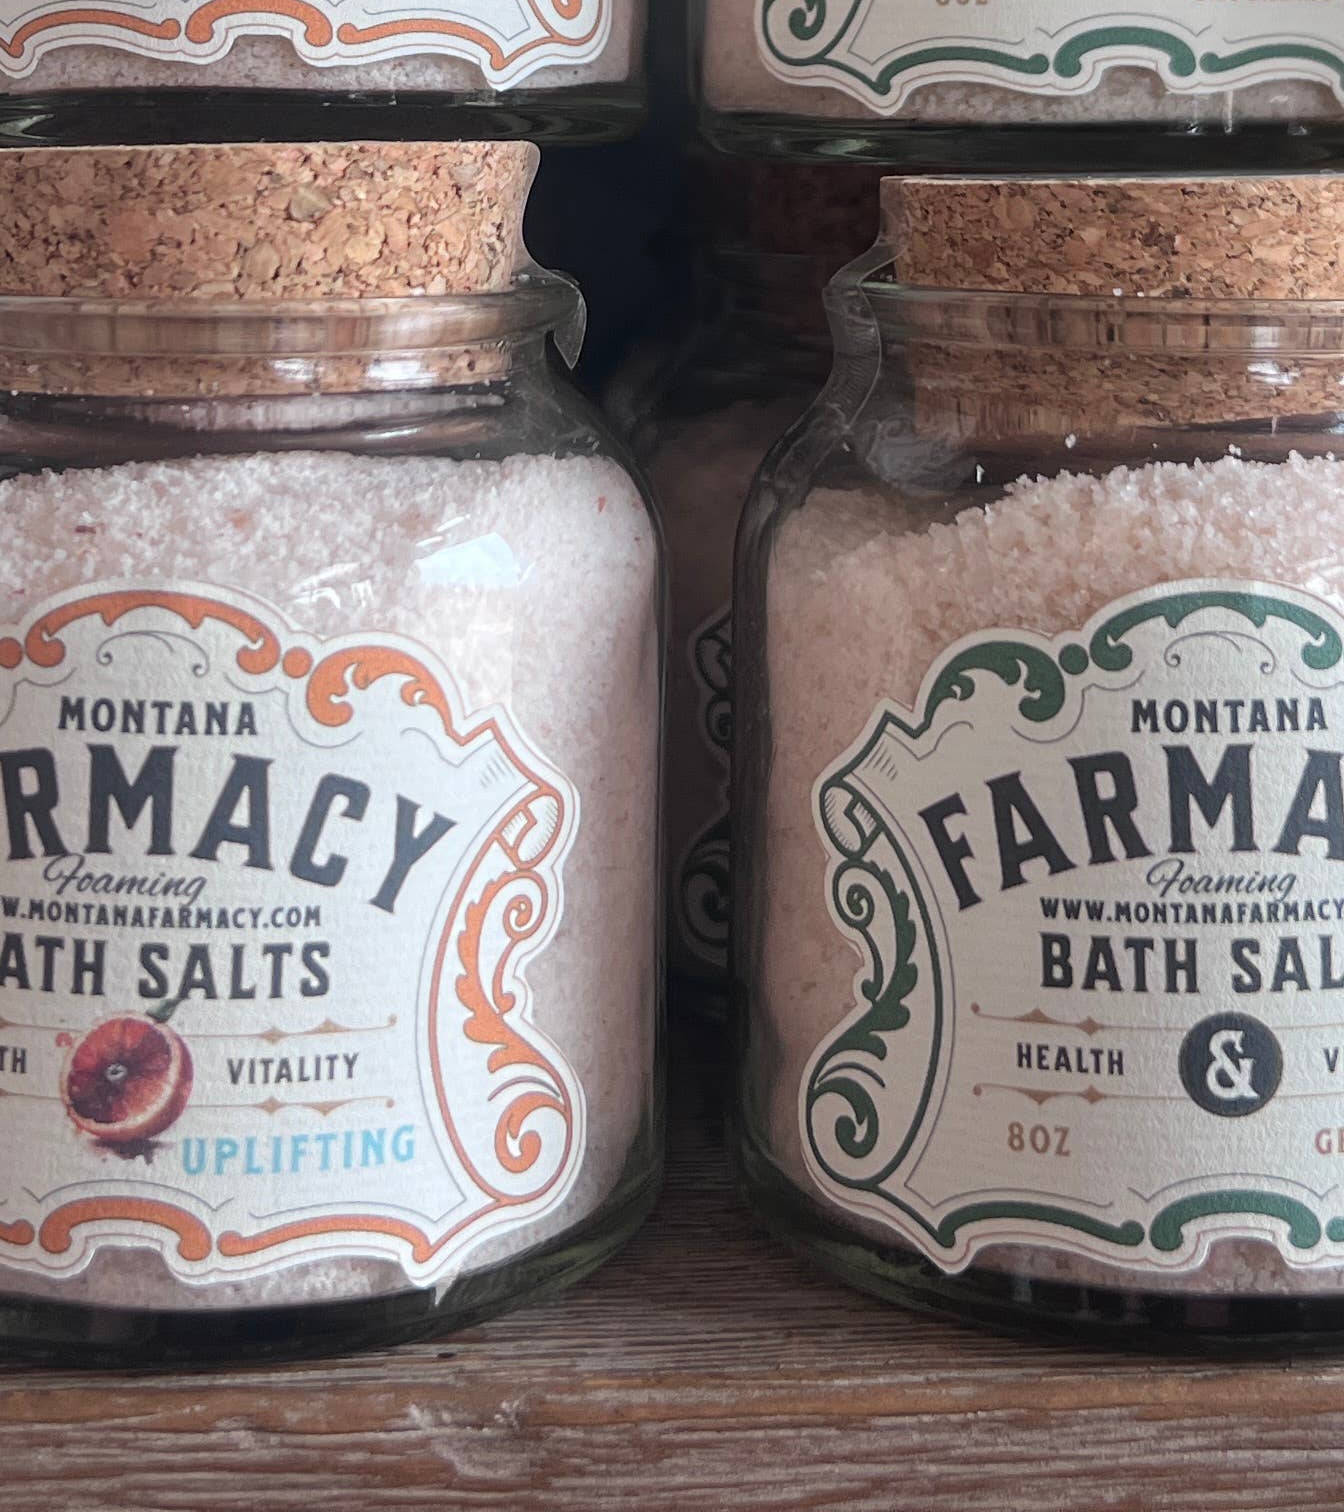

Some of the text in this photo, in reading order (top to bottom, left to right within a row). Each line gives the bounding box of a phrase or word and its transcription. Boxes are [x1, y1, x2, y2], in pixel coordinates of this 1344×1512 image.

[57, 695, 258, 736] MONTANA
[1131, 697, 1328, 734] MONTANA
[43, 853, 207, 904] Foaming
[1147, 858, 1296, 900] Foaming
[138, 942, 330, 1000] SALTS
[1040, 931, 1199, 994] BATH
[227, 1053, 359, 1085] VITALITY
[1016, 1042, 1124, 1075] HEALTH
[1207, 1030, 1260, 1101] &
[183, 1124, 414, 1175] UPLIFTING
[1007, 1121, 1071, 1157] 8OZ
